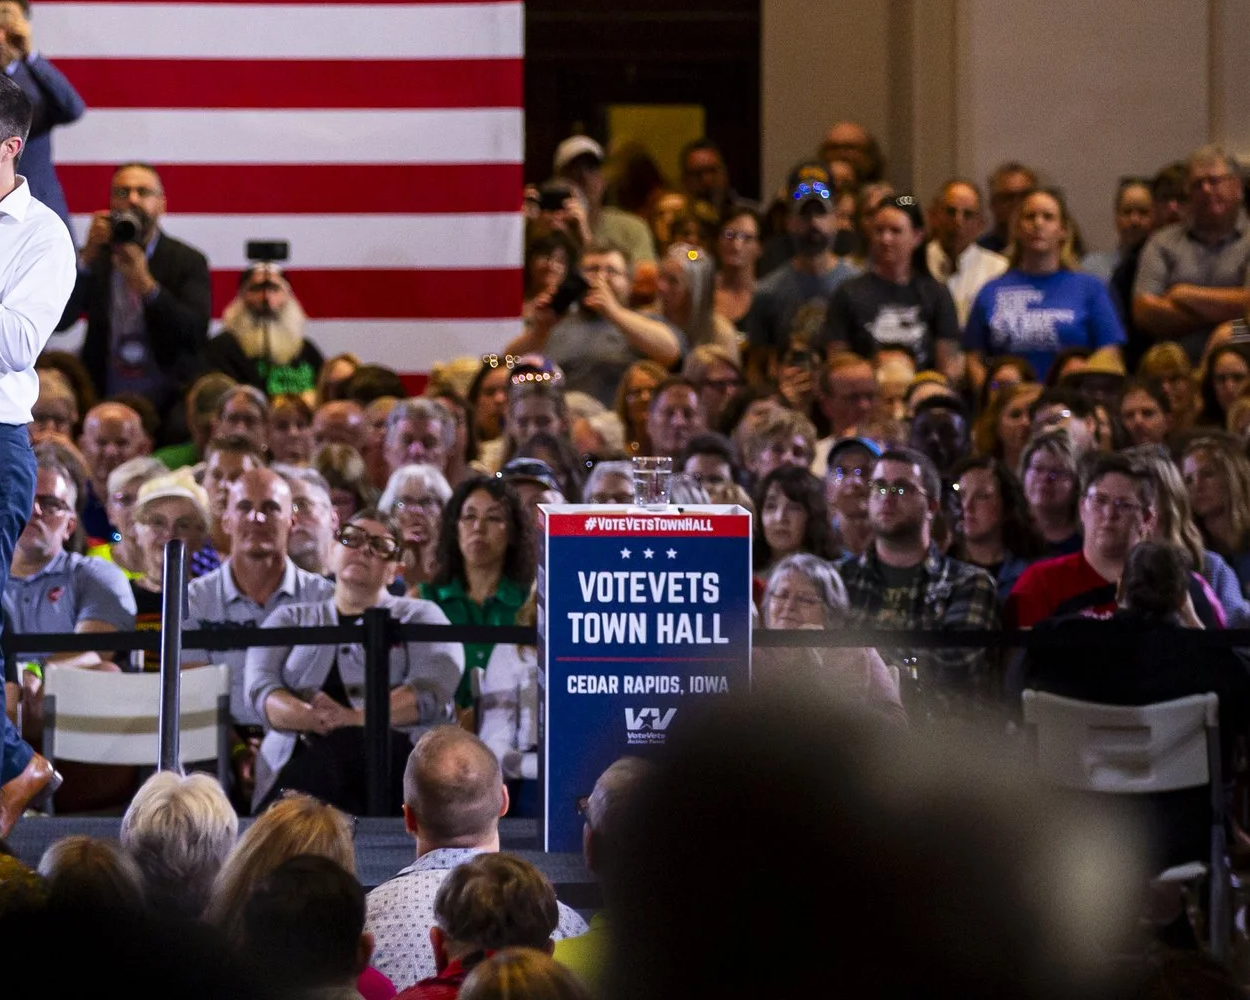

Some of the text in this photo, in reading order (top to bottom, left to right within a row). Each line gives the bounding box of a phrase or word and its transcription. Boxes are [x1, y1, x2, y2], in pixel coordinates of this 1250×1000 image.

[578, 571, 720, 603] VOTEVETS
[567, 612, 729, 644] TOWN HALL
[567, 675, 729, 696] CEDAR RAPIDS, IOWA
